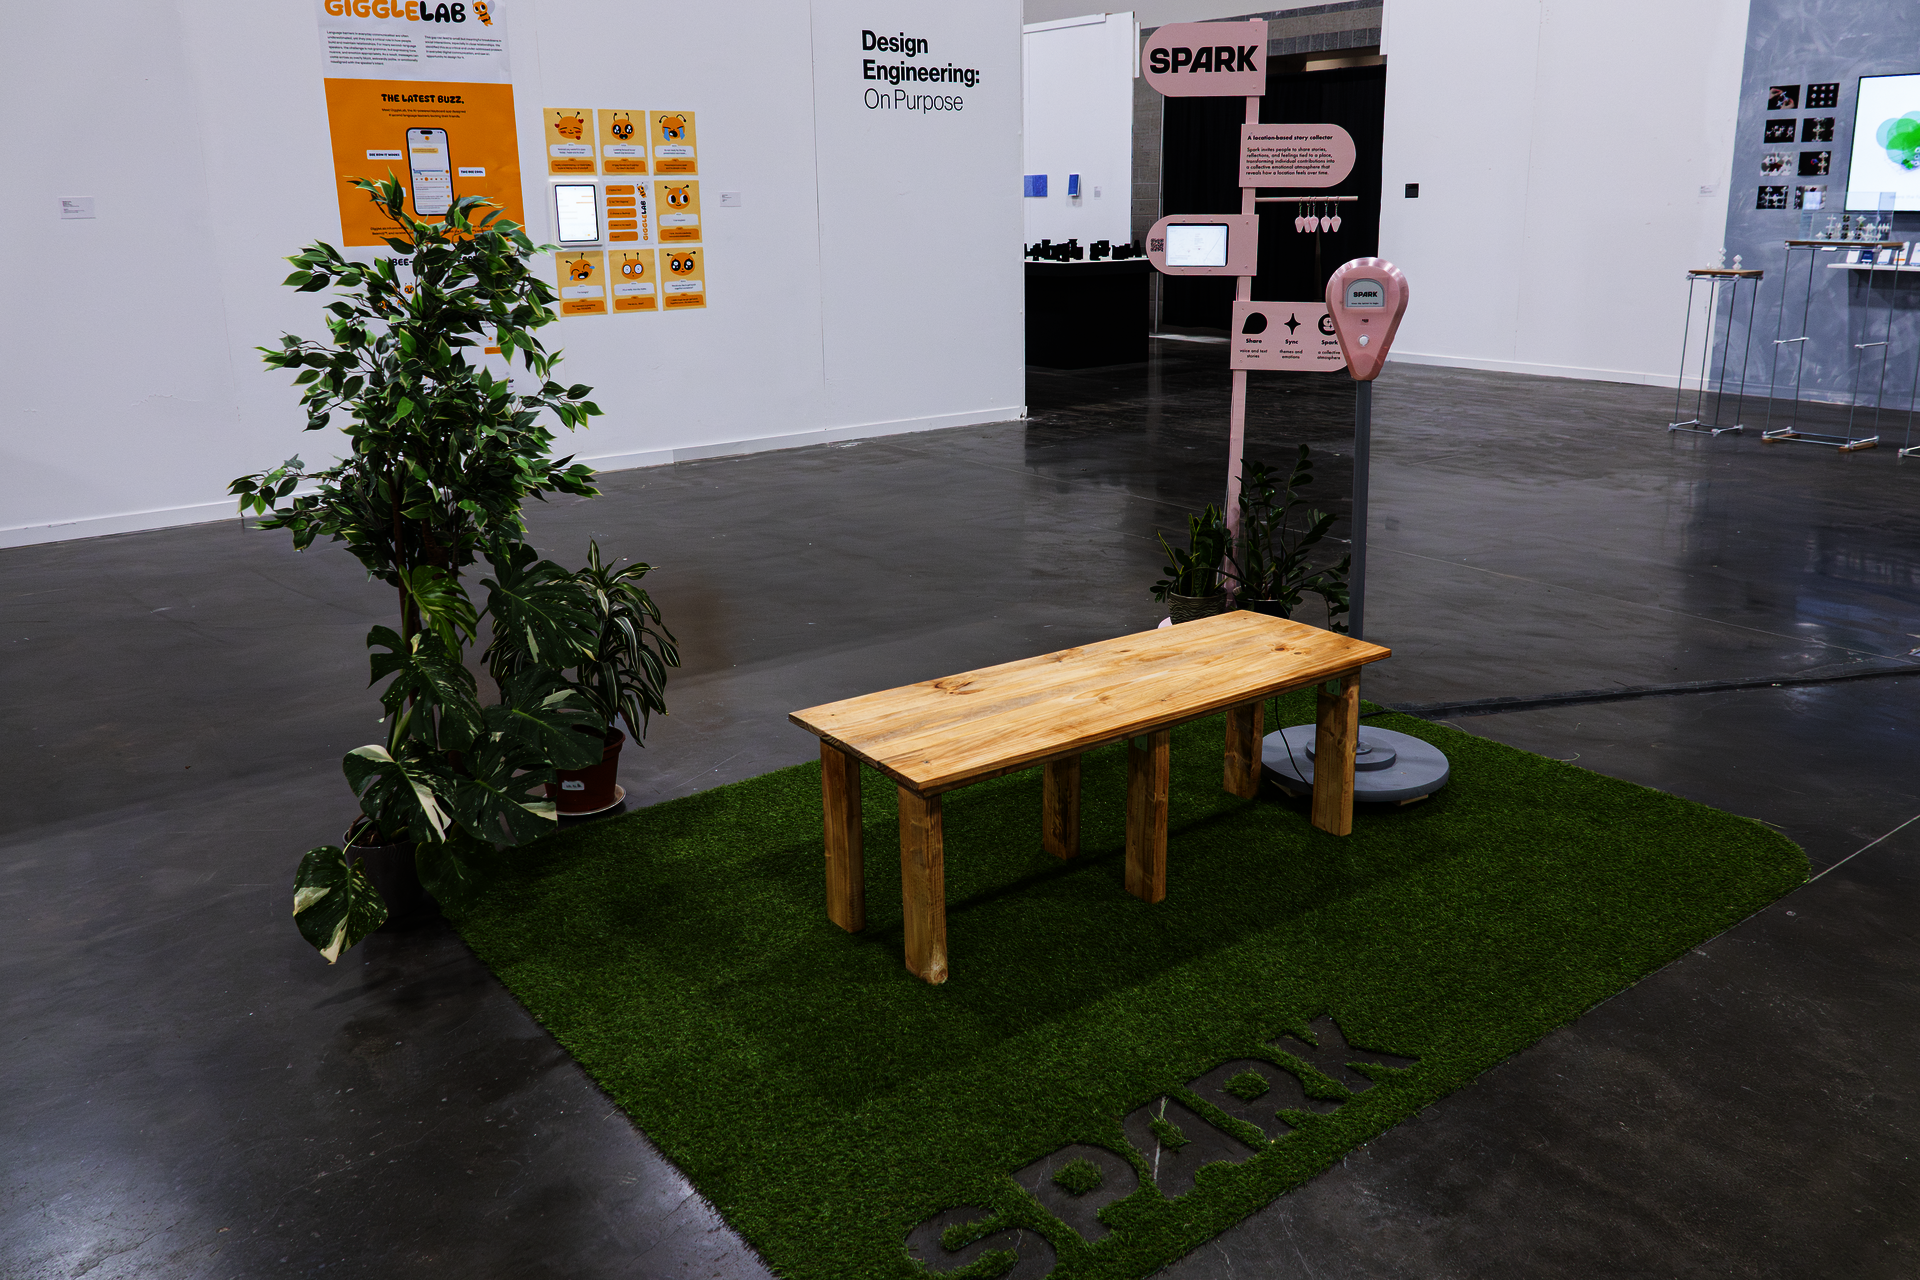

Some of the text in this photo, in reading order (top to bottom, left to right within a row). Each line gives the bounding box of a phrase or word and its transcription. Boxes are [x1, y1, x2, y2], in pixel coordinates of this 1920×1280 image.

[324, 0, 466, 23] GIGGLELAB
[862, 29, 928, 57] Design
[862, 58, 980, 88] Engineering:
[1150, 45, 1258, 74] SPARK
[381, 94, 400, 102] THE
[402, 94, 436, 103] LATEST
[864, 88, 964, 114] On Purpose
[905, 1014, 1422, 1280] SPARK
